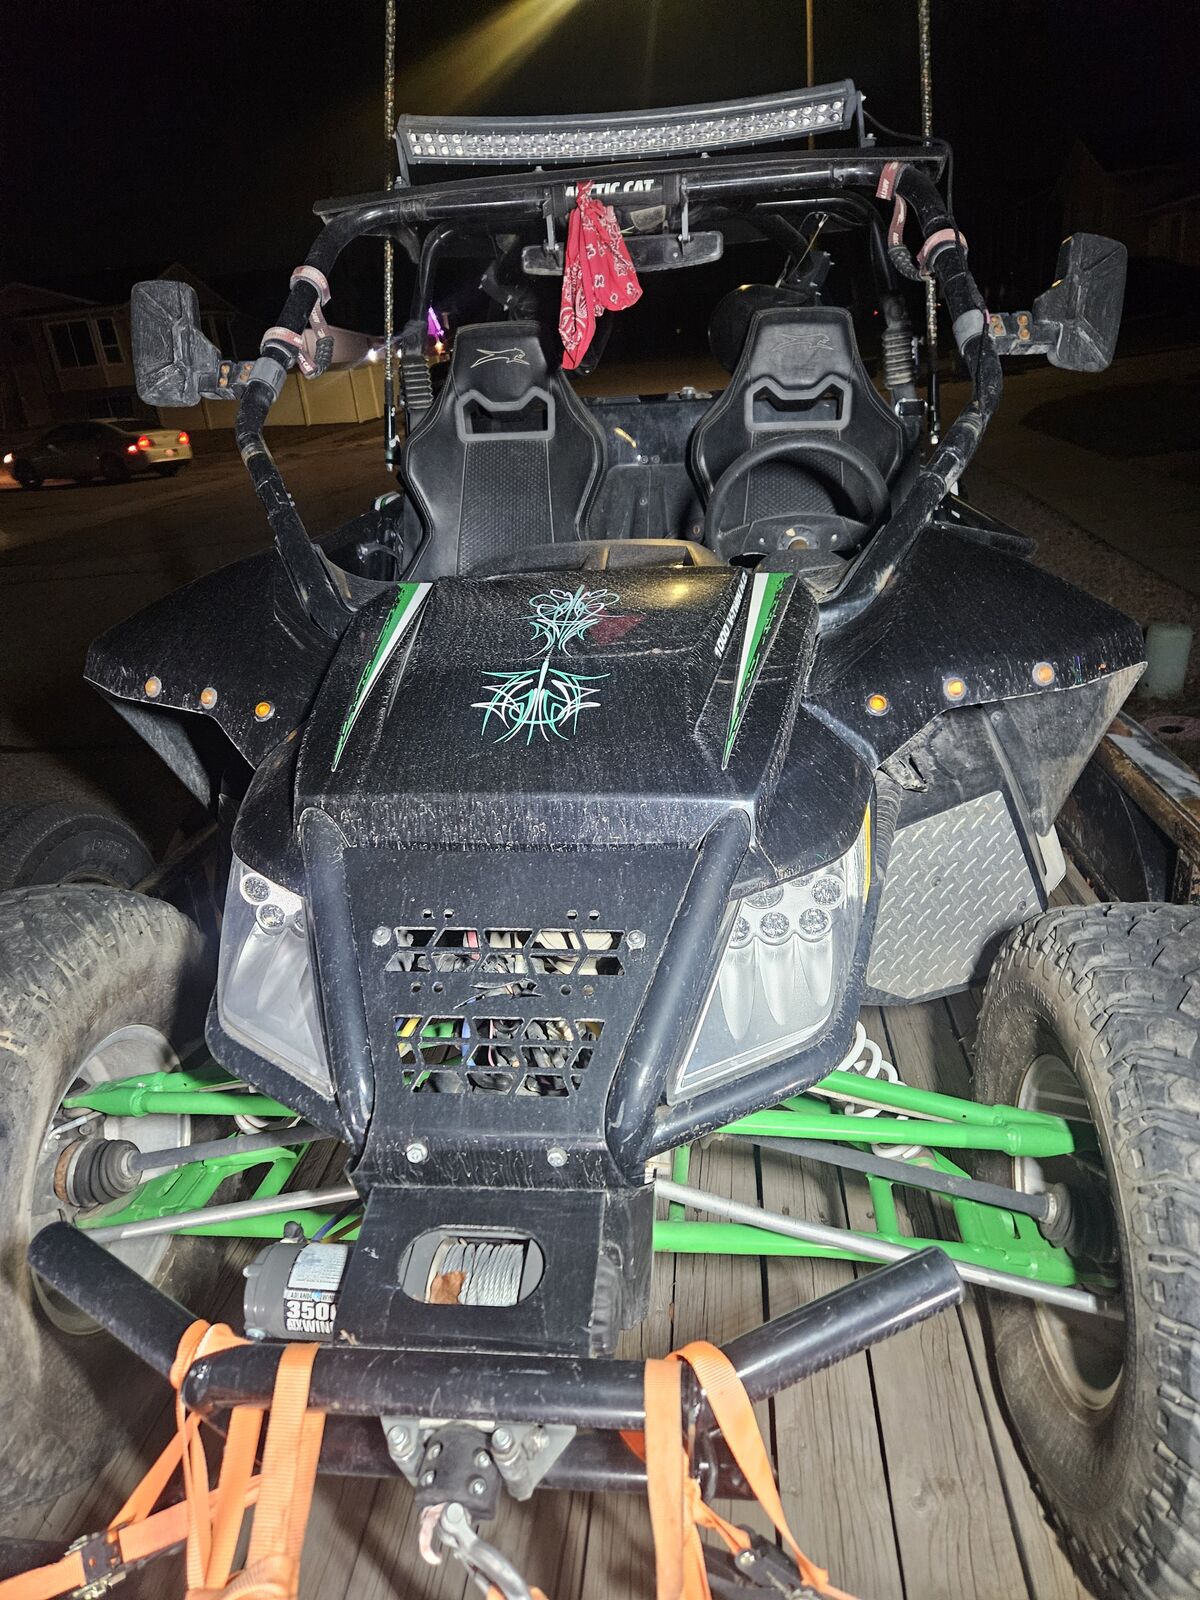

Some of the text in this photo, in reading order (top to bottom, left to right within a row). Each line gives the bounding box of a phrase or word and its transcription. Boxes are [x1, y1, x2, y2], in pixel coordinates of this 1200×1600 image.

[623, 179, 654, 192] CAT
[714, 623, 731, 660] 1000
[1029, 981, 1058, 1021] TIRES
